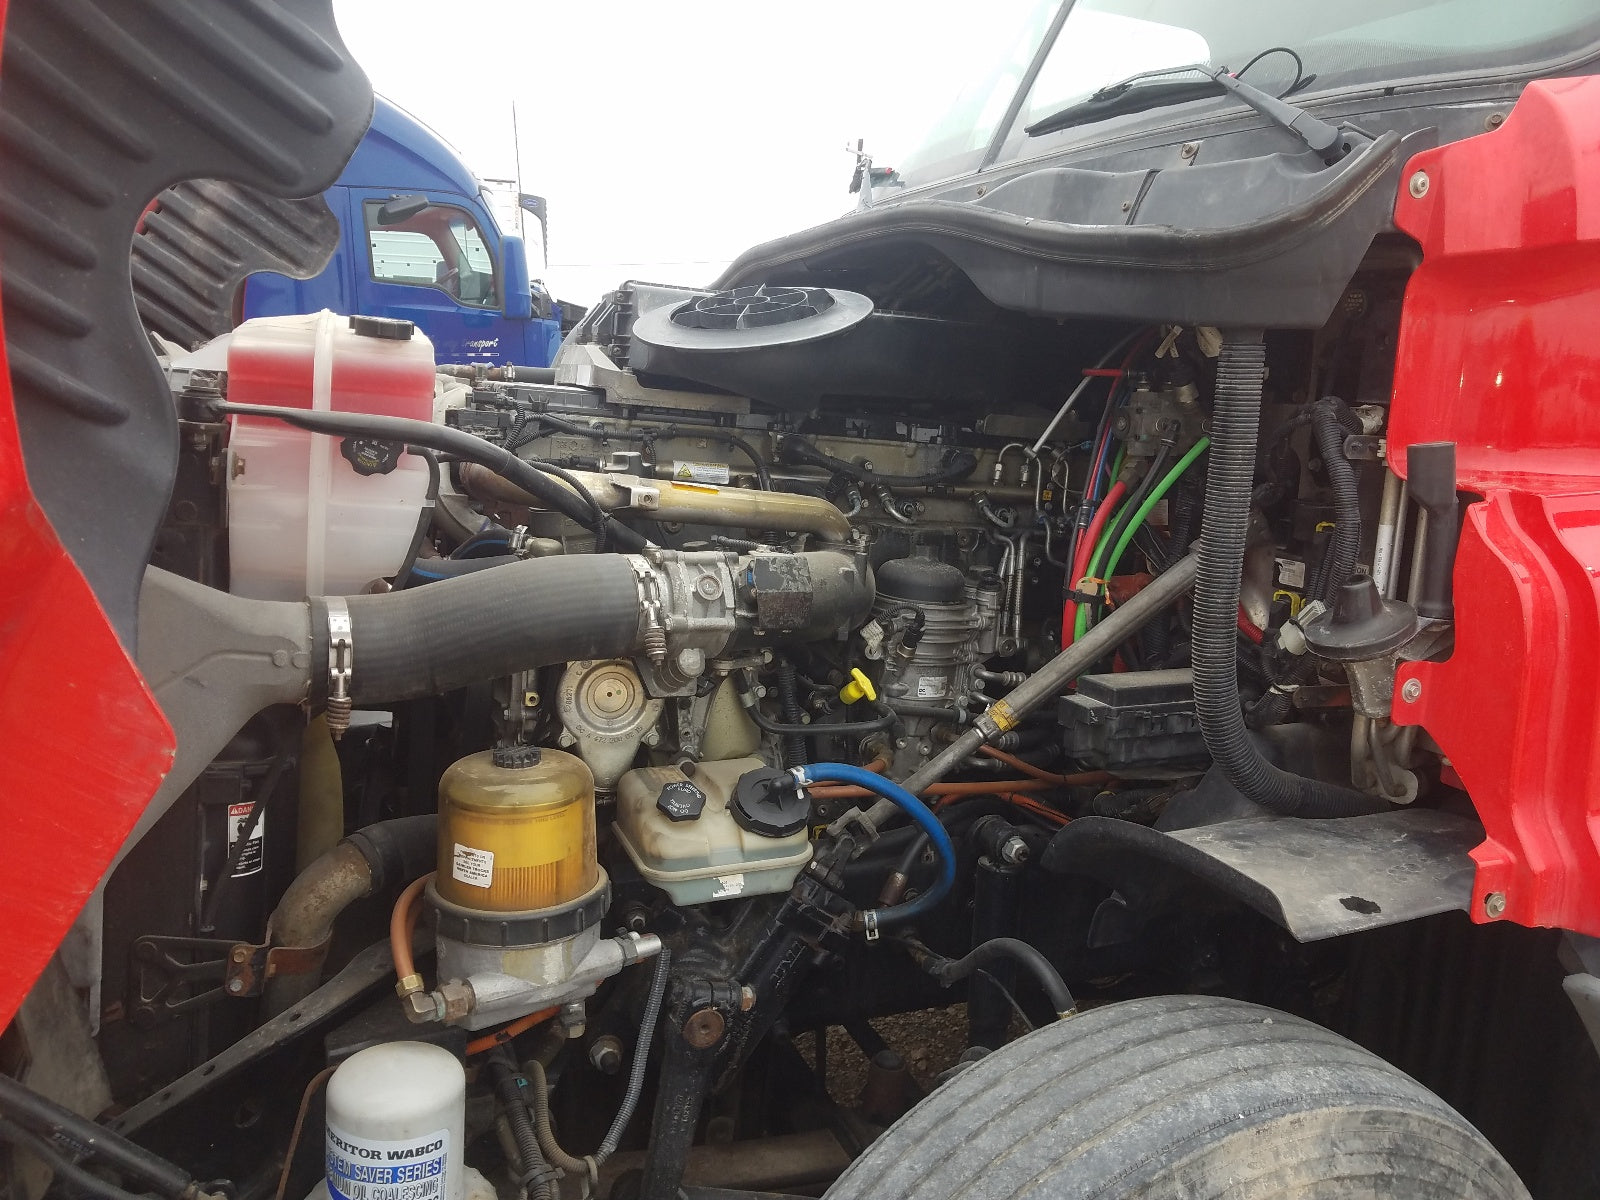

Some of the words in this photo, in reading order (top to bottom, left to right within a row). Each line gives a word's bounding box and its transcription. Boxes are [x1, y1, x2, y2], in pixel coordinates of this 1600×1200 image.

[387, 1139, 443, 1161] WABCO
[354, 1163, 393, 1185] SAVER
[396, 1158, 440, 1184] SERIES
